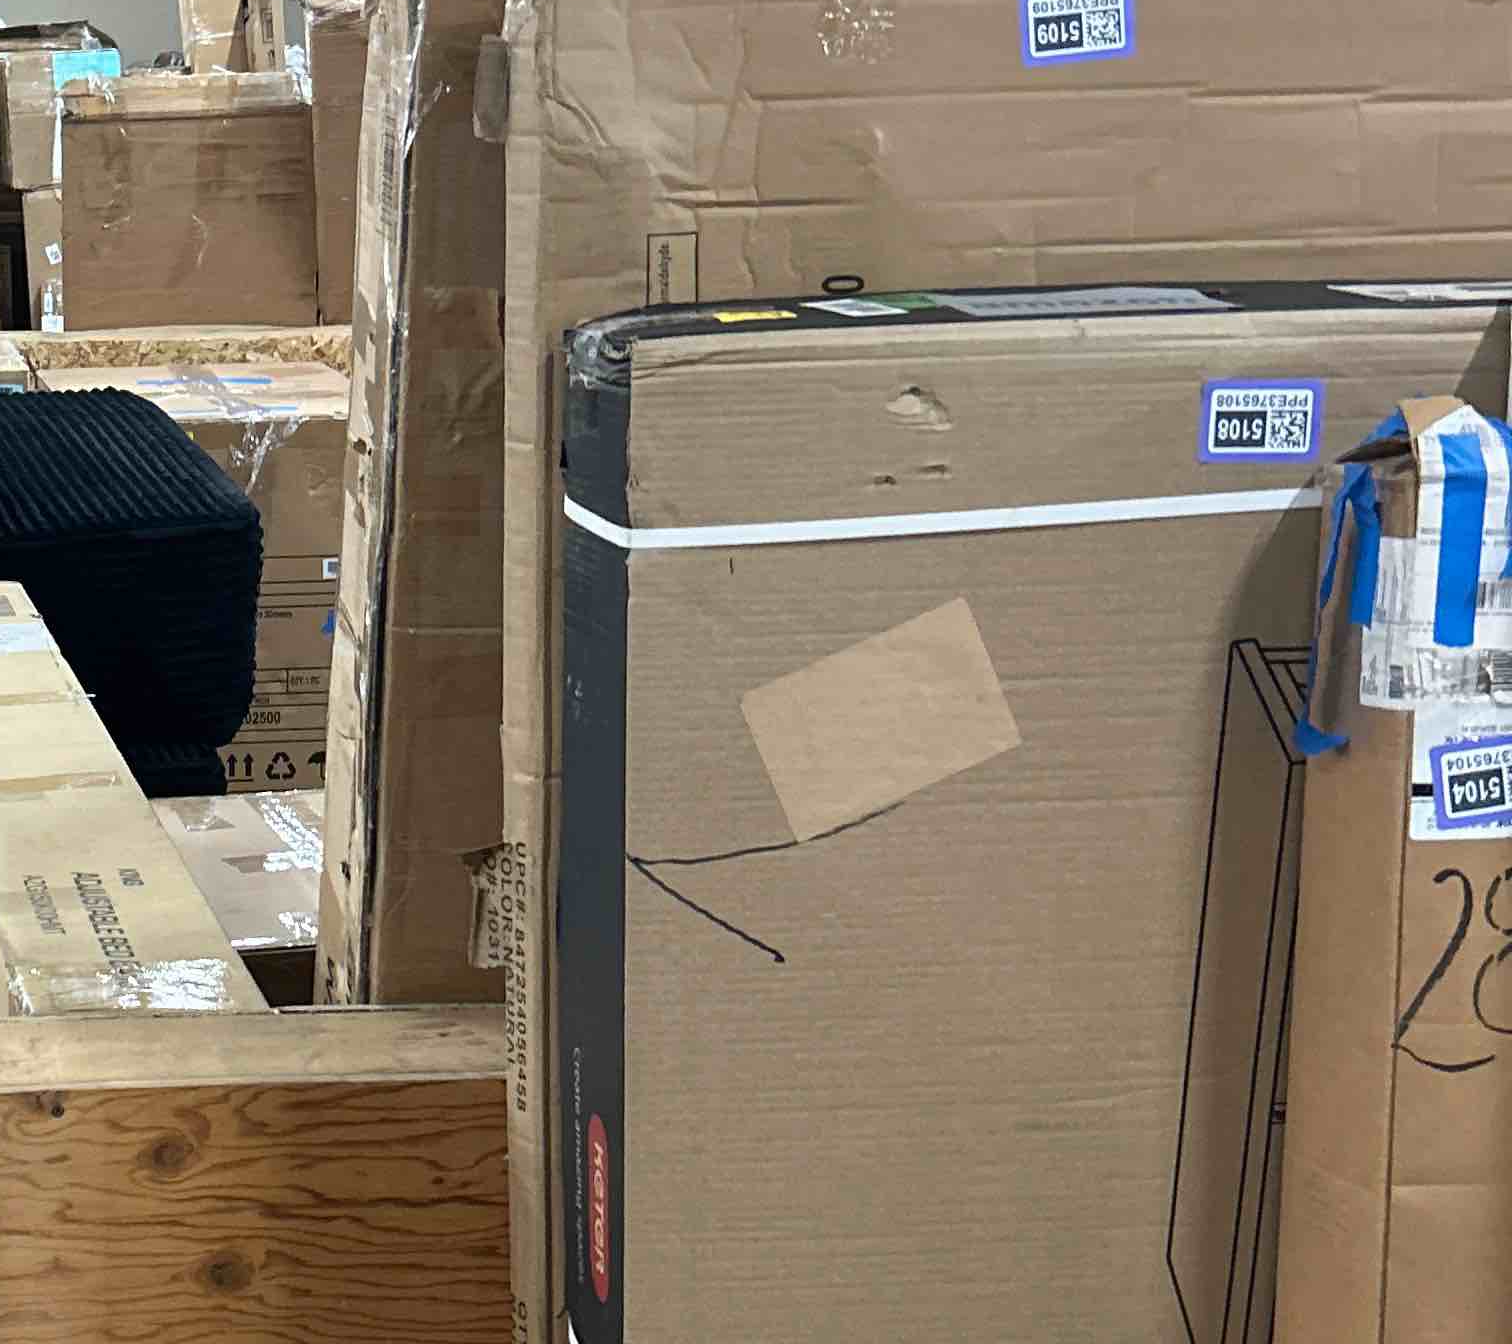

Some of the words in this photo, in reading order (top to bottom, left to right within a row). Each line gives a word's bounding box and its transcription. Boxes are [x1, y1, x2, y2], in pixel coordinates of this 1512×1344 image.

[1037, 20, 1080, 45] 5109
[1216, 394, 1309, 408] PPE3765108
[1218, 418, 1263, 440] 5108
[1451, 775, 1501, 806] 5104
[71, 871, 126, 936] ADJUSTABLE
[99, 936, 135, 959] BED
